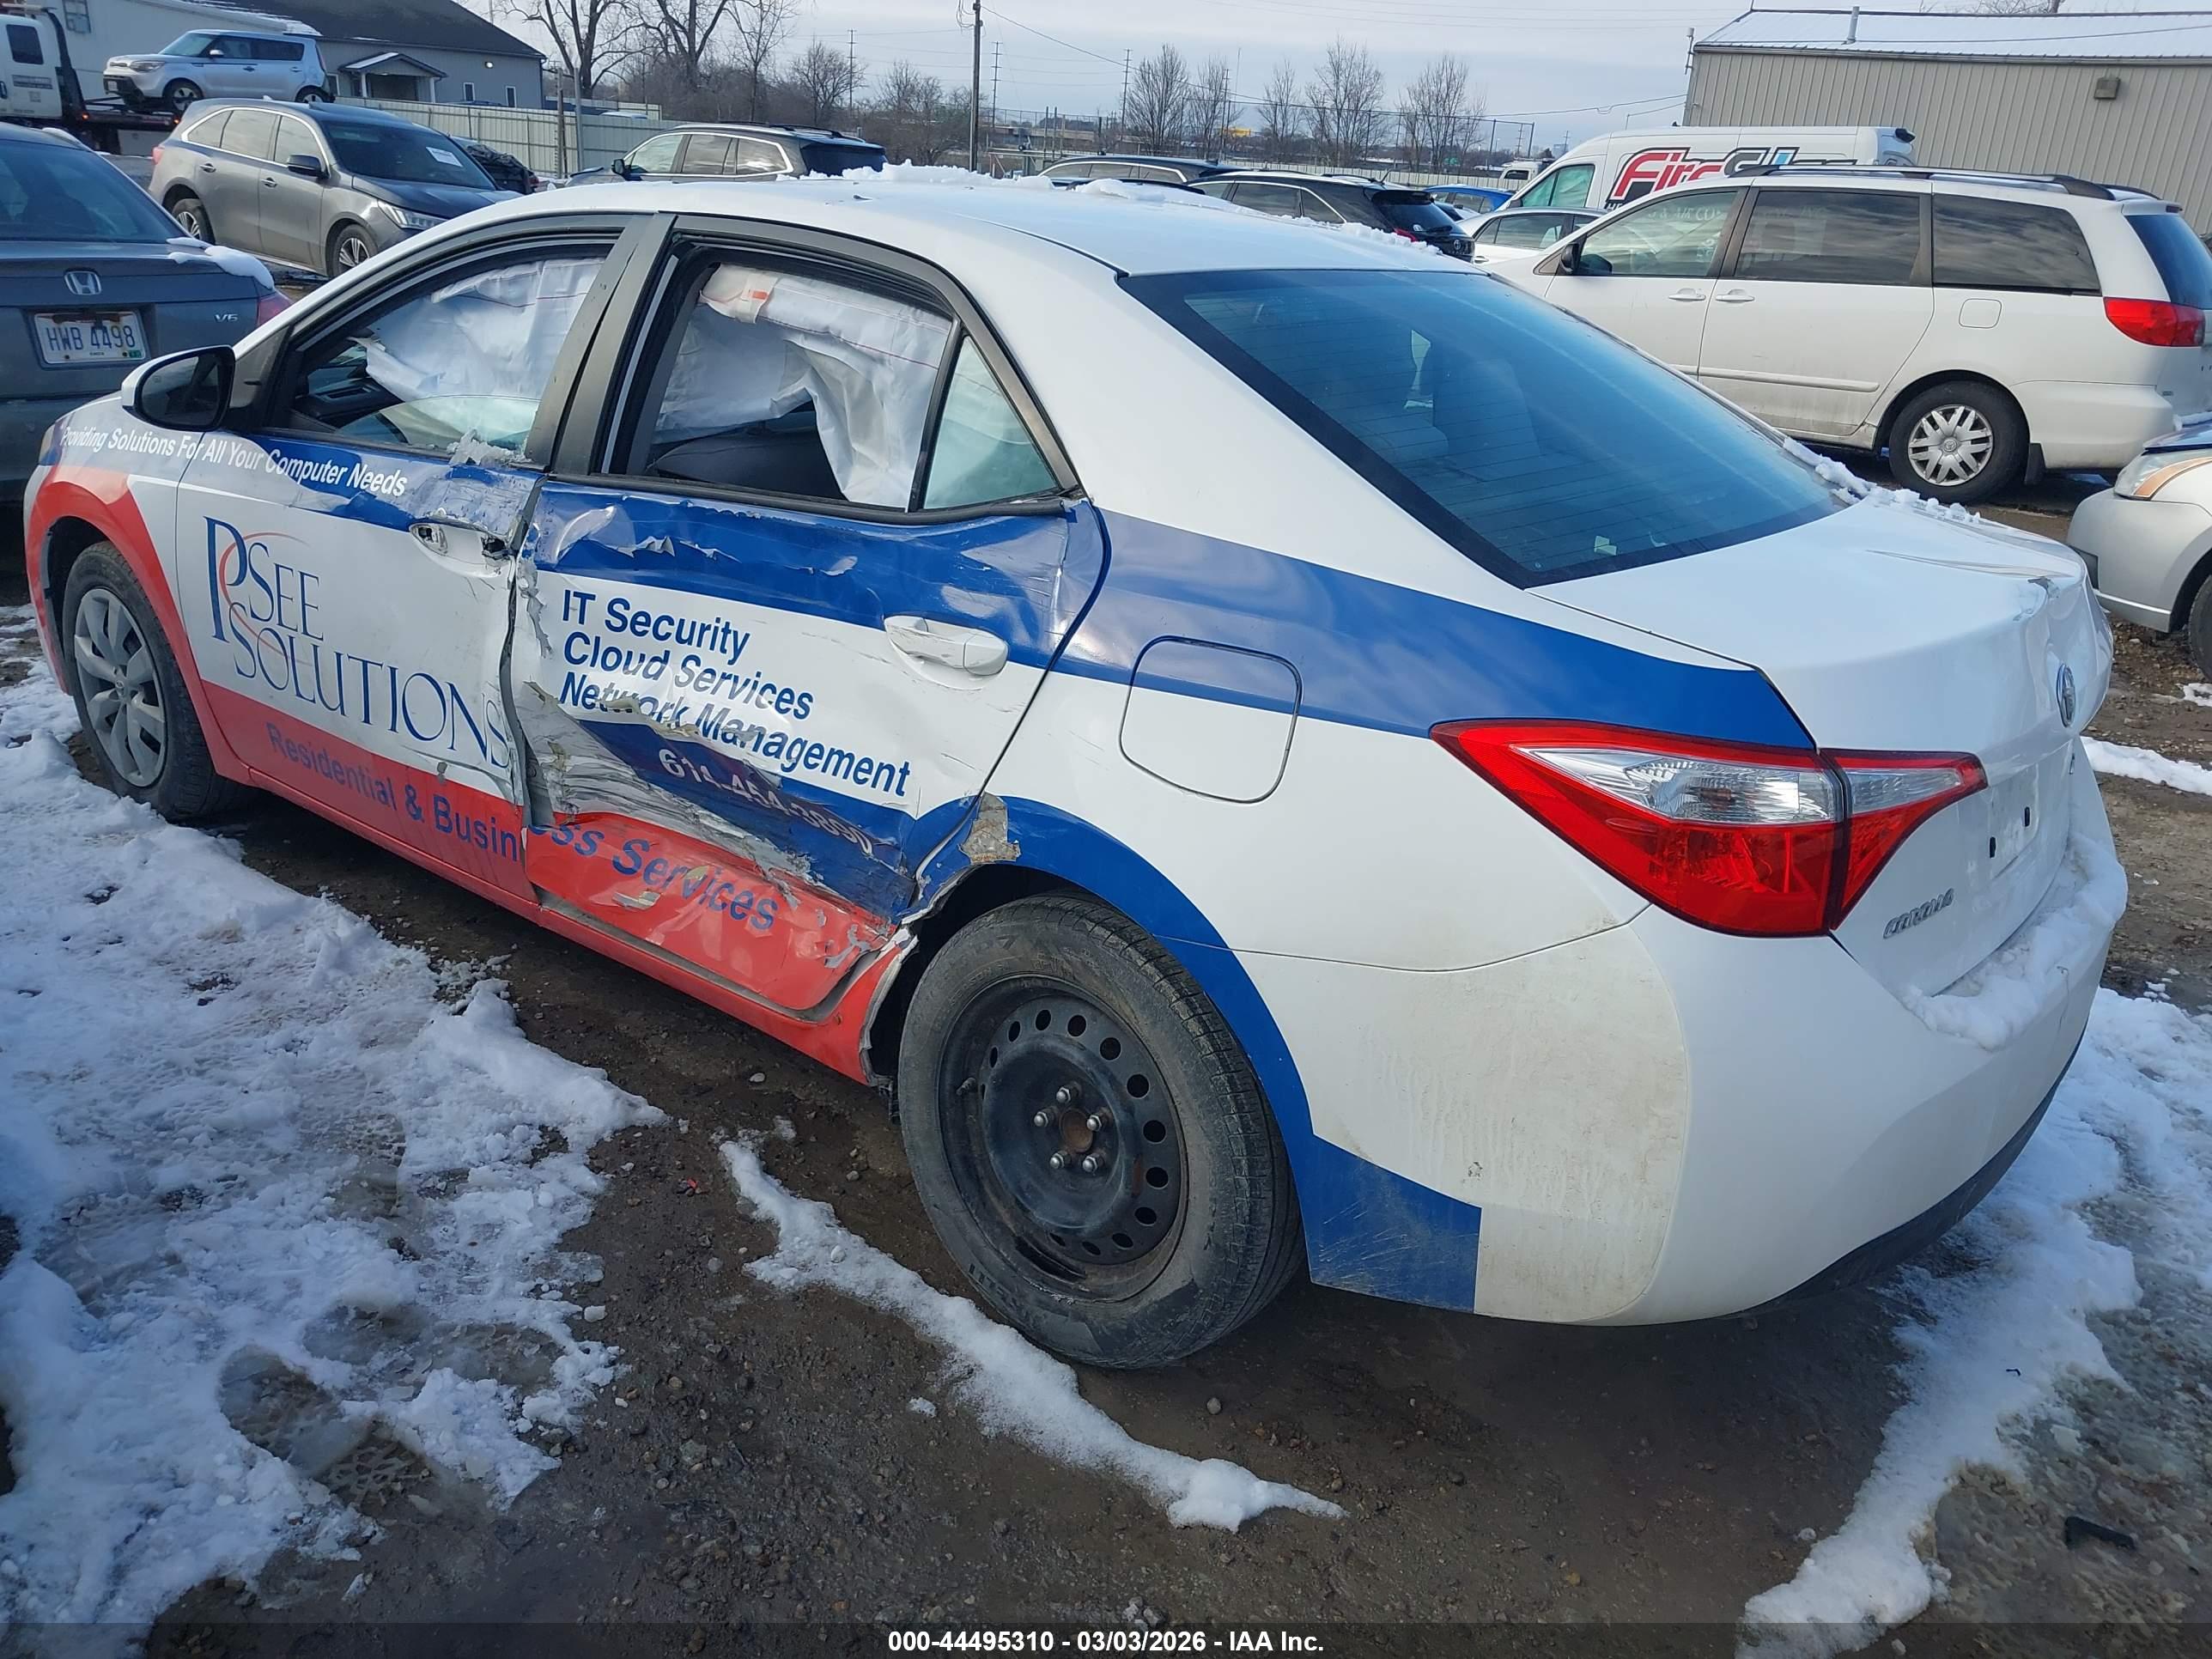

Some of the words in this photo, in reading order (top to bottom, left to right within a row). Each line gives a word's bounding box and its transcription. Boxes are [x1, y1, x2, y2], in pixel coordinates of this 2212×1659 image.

[46, 326, 83, 350] HWB
[90, 325, 136, 349] 4498
[214, 313, 239, 322] V6
[59, 424, 108, 453] Providing
[108, 428, 175, 457] Solutions
[176, 435, 204, 459] For
[202, 439, 228, 465] All
[228, 441, 263, 470] Your
[265, 449, 348, 485] Computer
[347, 463, 408, 496] Needs
[562, 589, 596, 625] IT
[605, 598, 750, 665] Security
[228, 602, 509, 769] SOLUTIONS
[564, 631, 671, 680] Cloud
[674, 654, 813, 720] Services
[696, 703, 910, 797] Management
[266, 723, 397, 811] Residential
[404, 784, 425, 823] &
[612, 839, 778, 931] Services
